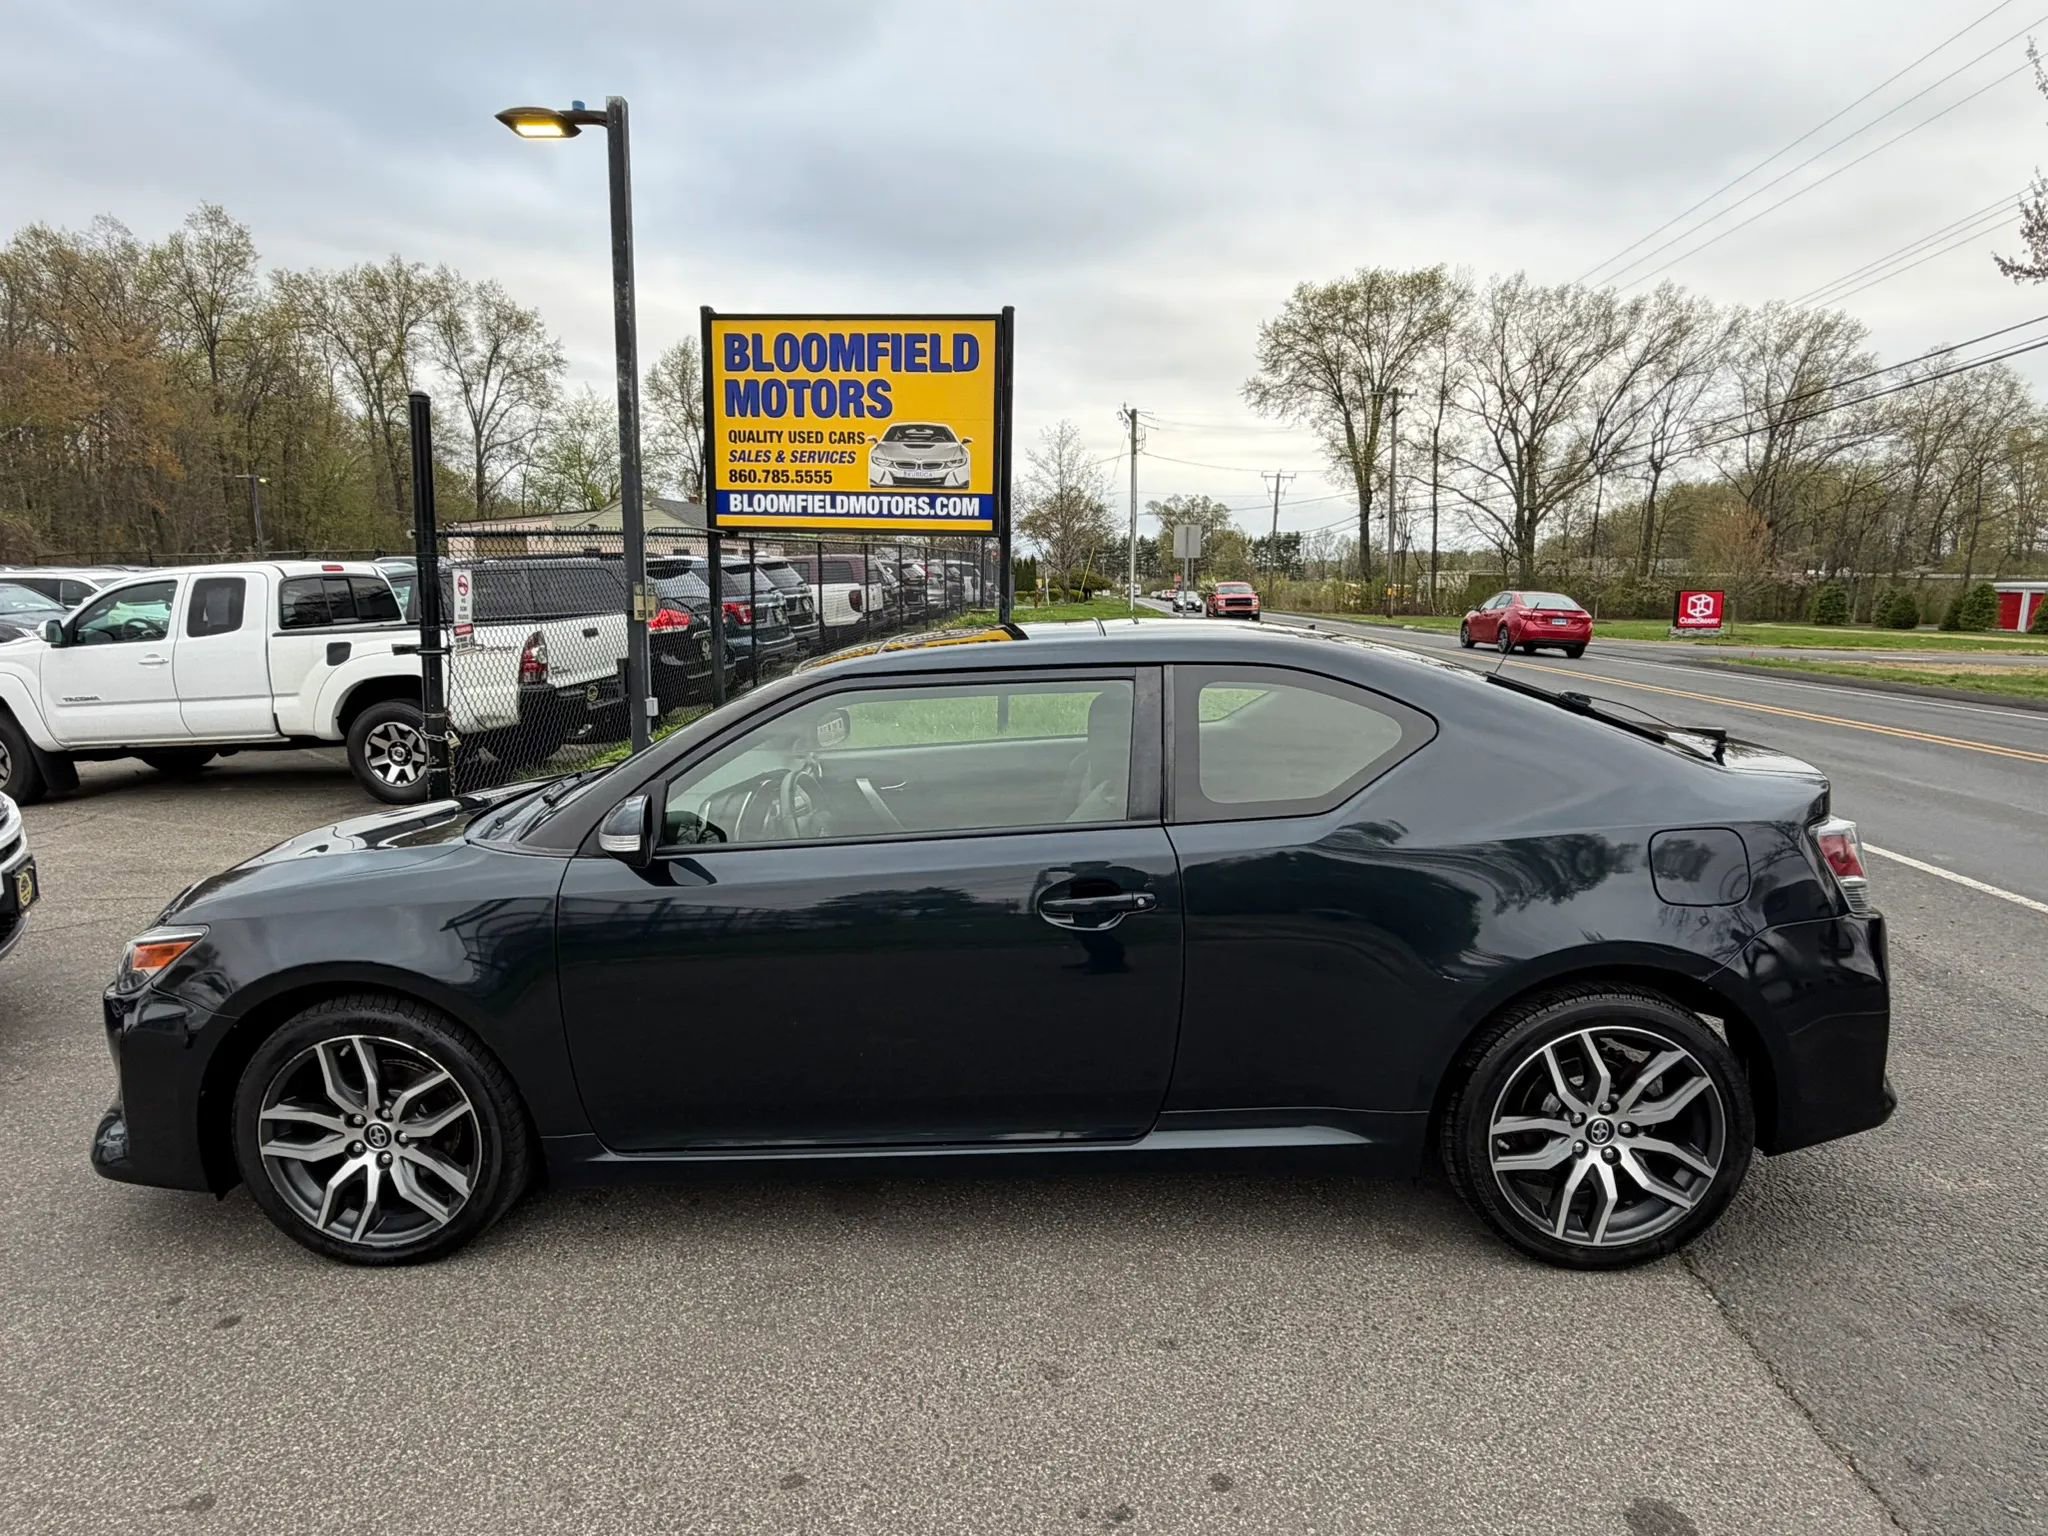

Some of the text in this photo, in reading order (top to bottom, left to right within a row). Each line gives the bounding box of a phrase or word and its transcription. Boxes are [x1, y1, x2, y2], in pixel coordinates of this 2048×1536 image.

[723, 332, 980, 373] BLOOMFIELD
[724, 378, 893, 419] MOTORS
[728, 429, 866, 445] QUALITY USED CARS
[728, 449, 857, 464] SALES & SERVICES
[728, 469, 833, 484] 860.785.5555
[729, 493, 980, 517] BLOOMFIELDMOTORS.COM
